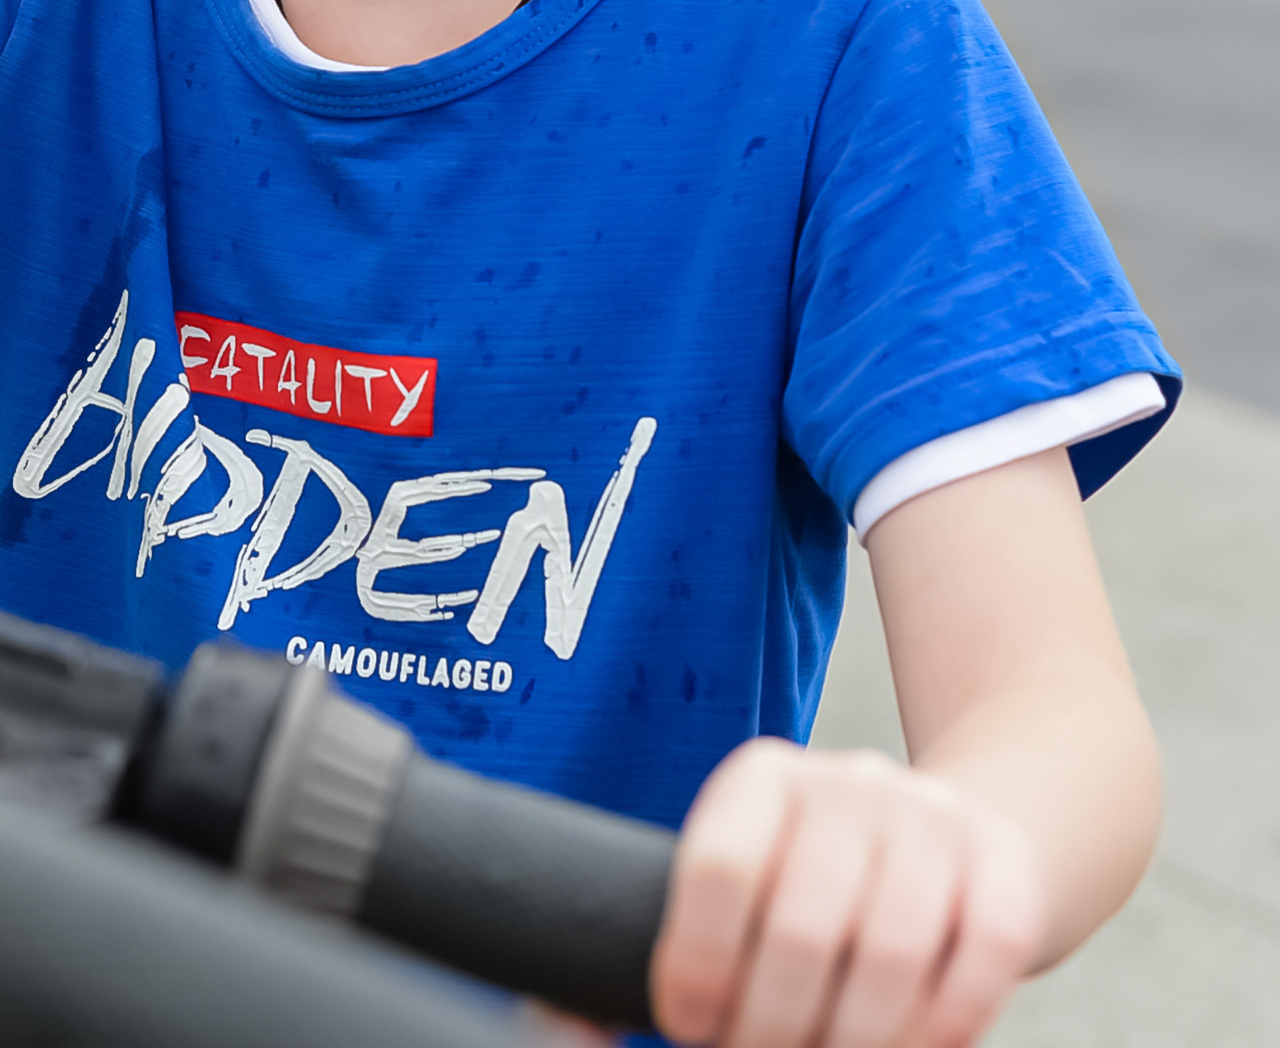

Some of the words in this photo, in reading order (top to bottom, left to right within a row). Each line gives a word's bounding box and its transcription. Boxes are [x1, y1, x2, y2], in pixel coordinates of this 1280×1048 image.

[179, 324, 430, 427] FATALITY
[12, 288, 659, 661] HIDDEN
[286, 636, 513, 693] CAMOUFLAGED
